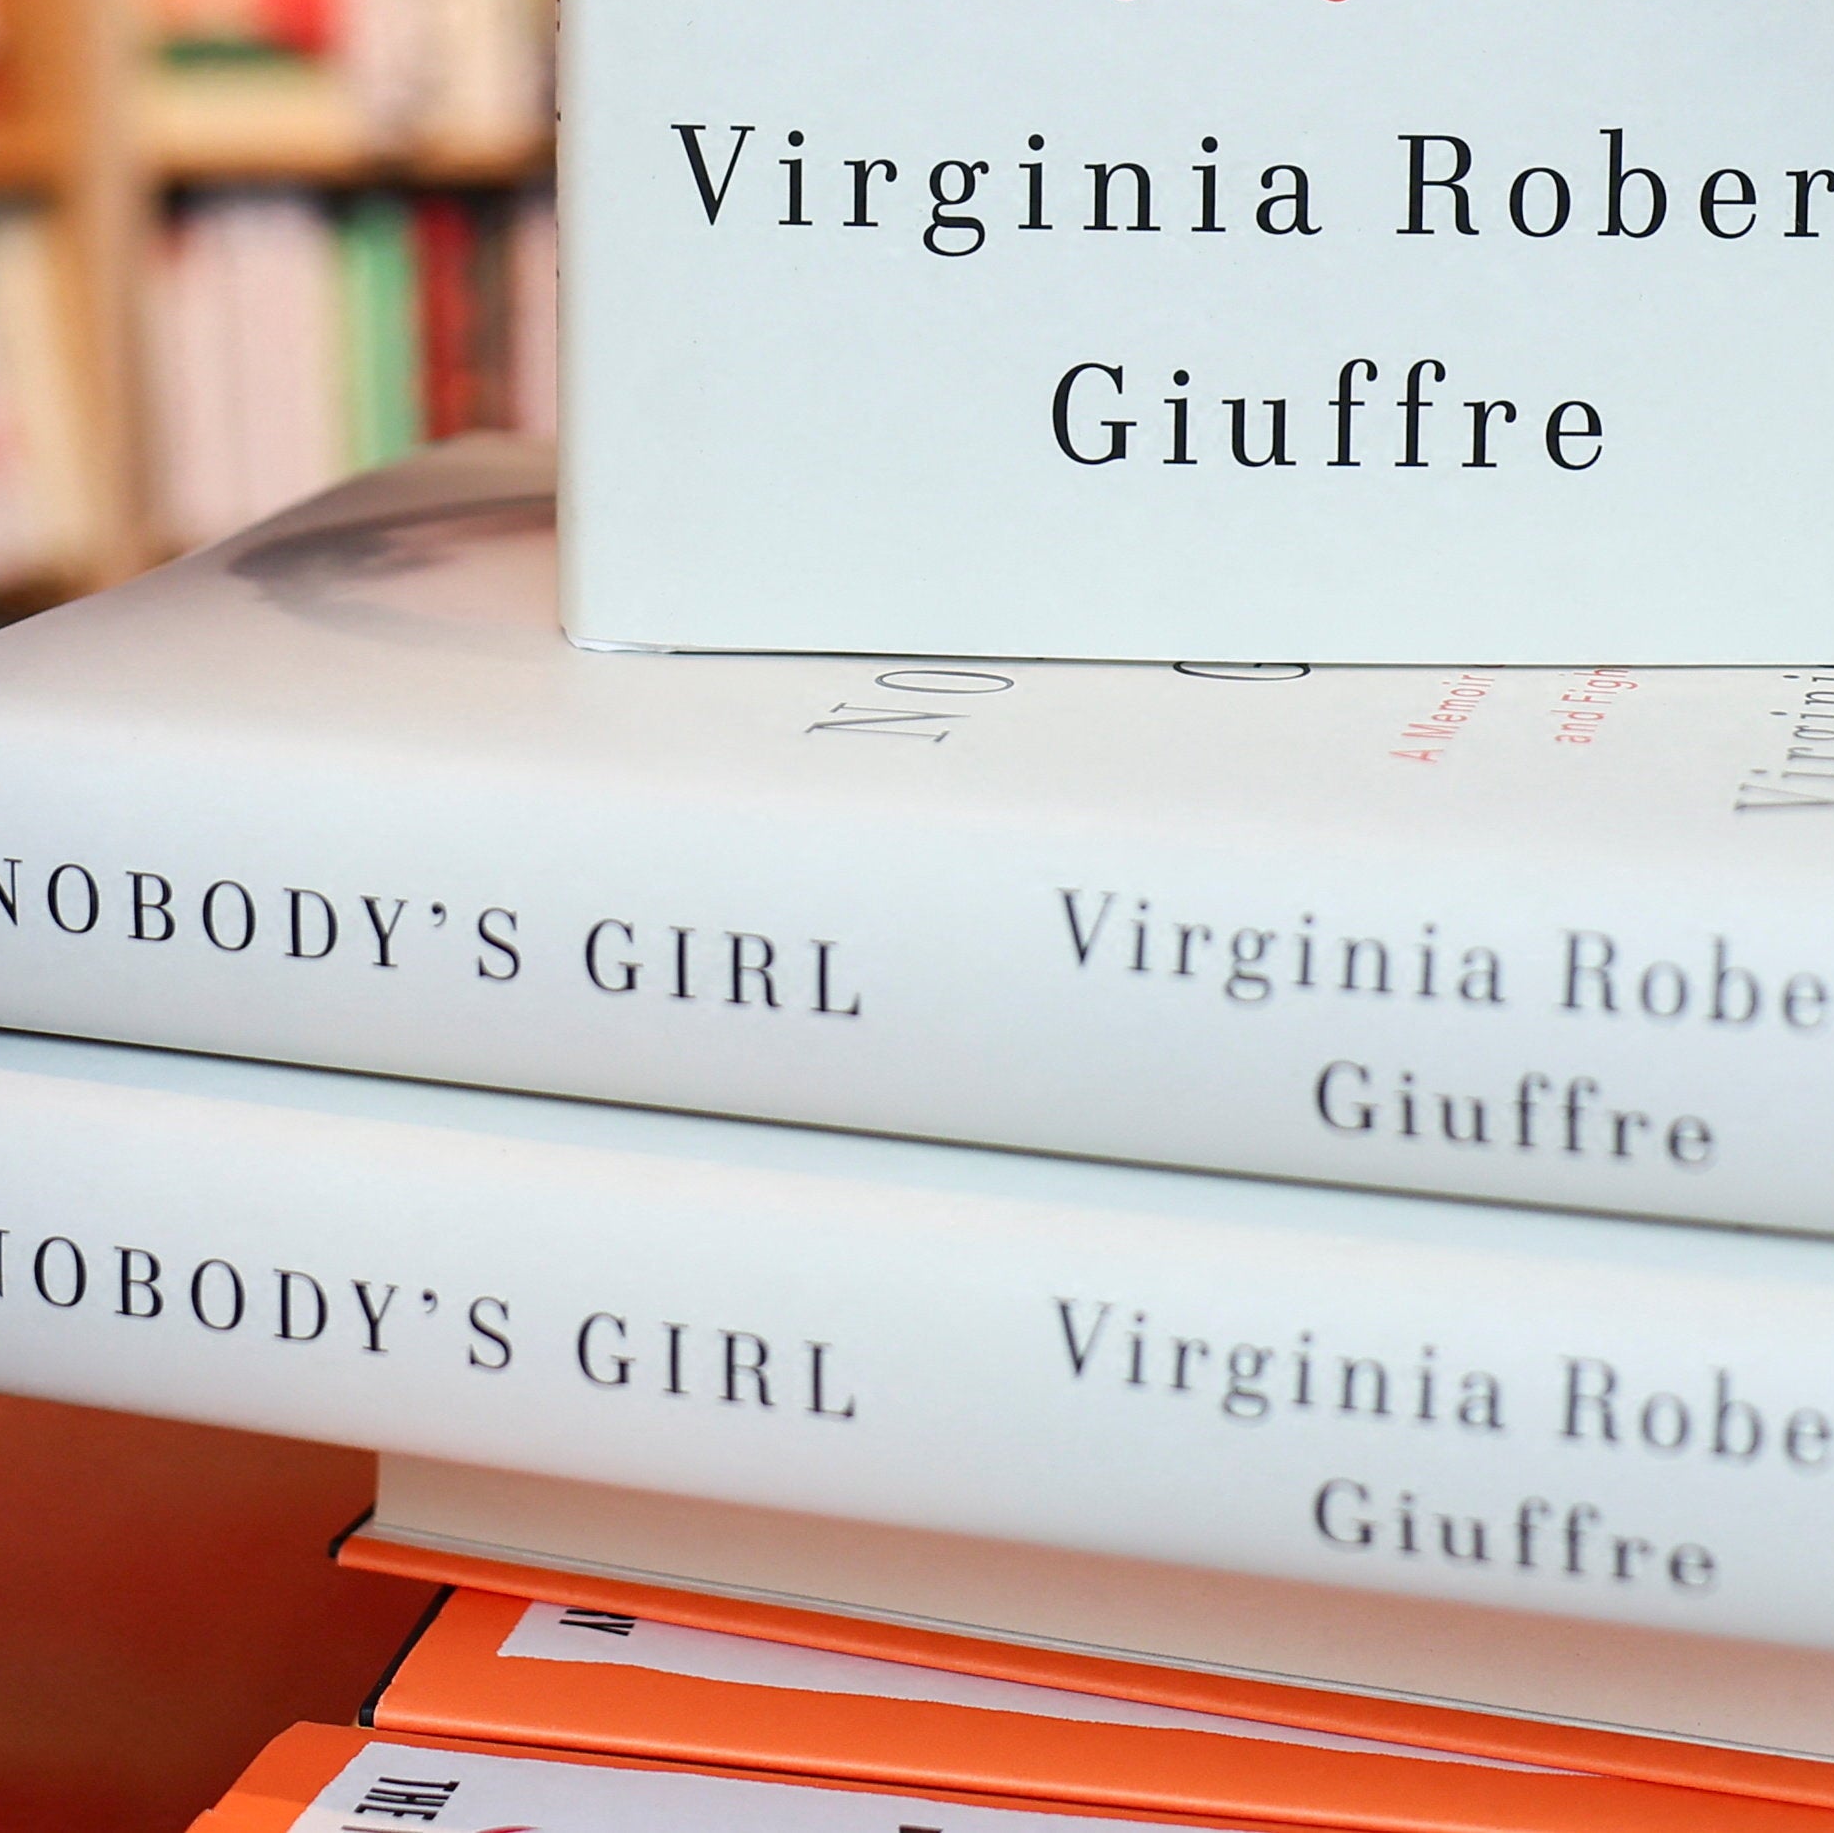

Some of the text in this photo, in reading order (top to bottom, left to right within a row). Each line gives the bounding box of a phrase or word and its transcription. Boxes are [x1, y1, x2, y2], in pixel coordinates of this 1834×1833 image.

[670, 123, 1323, 258] Virginia
[1051, 358, 1604, 472] Giuffre
[1389, 674, 1495, 764] A Memoir
[1551, 709, 1605, 744] and
[585, 918, 861, 1018] GIRL
[1057, 888, 1507, 1003] Virginia
[1314, 1058, 1715, 1166] Giuffre
[576, 1310, 857, 1420] GIRL
[1053, 1296, 1507, 1433] Virginia
[1313, 1477, 1717, 1590] Giuffre
[354, 1776, 461, 1822] THE
